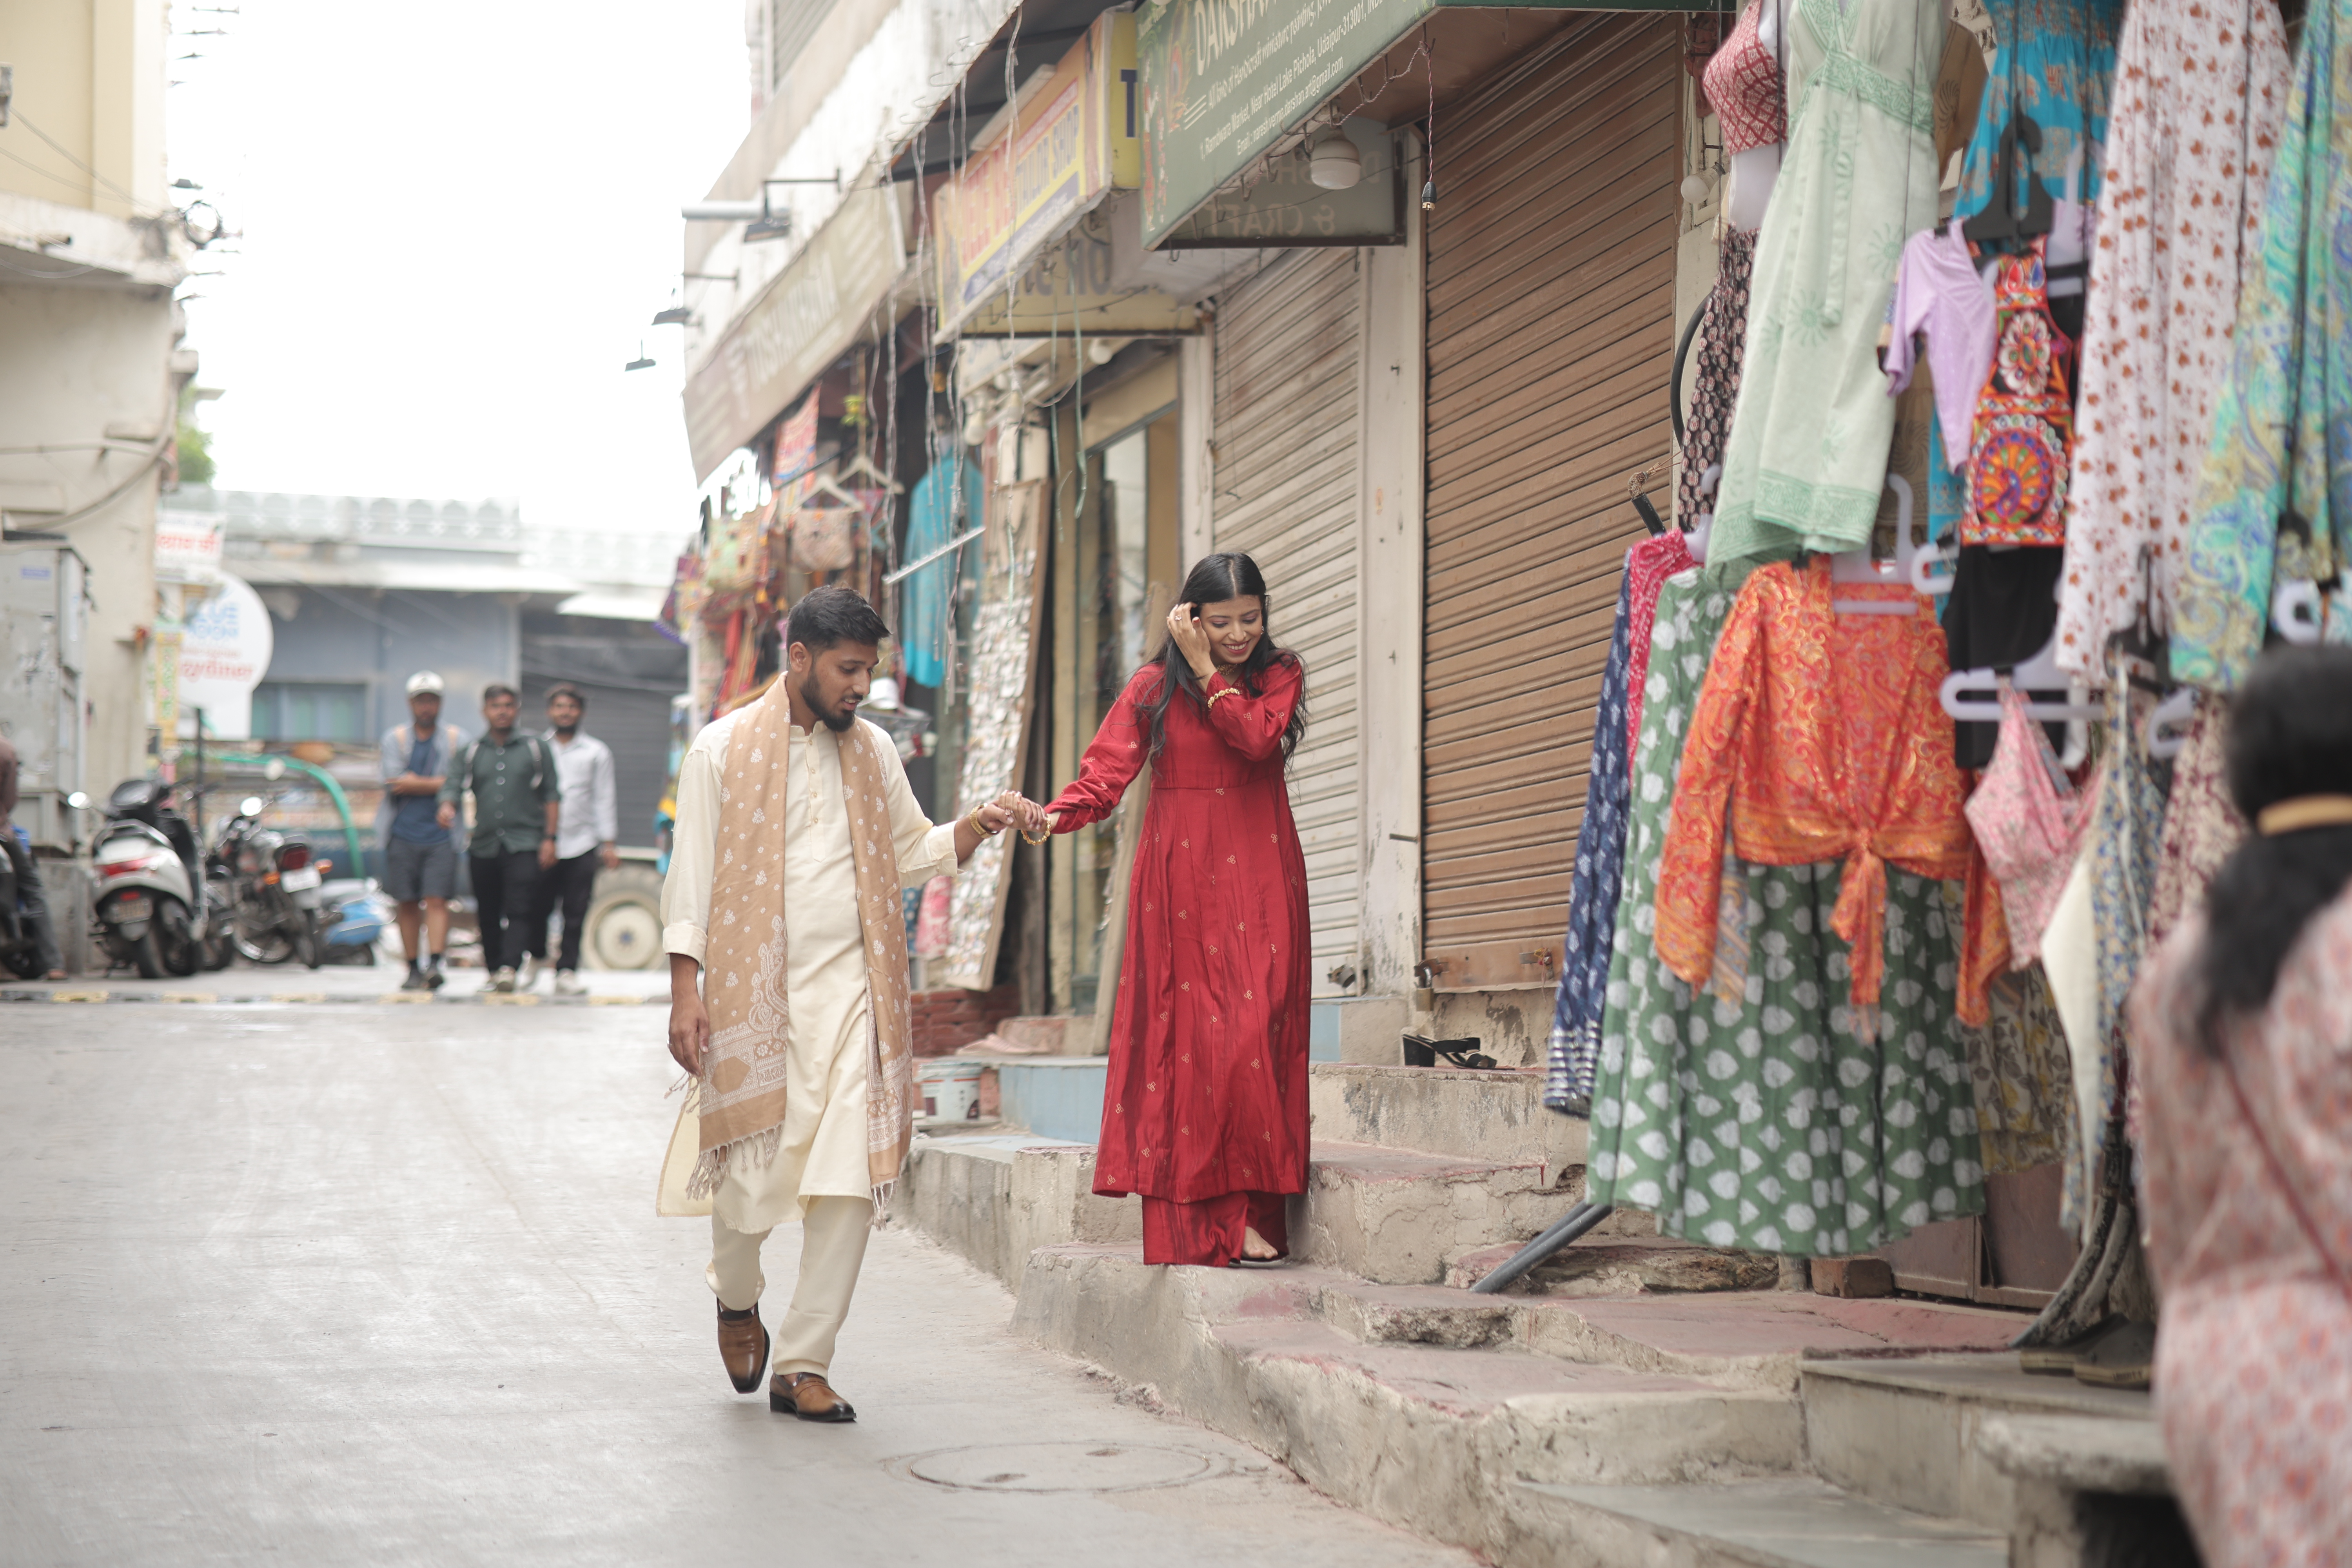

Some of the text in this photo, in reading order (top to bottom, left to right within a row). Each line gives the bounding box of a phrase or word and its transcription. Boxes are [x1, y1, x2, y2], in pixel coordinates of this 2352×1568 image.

[1250, 94, 1263, 116] Near
[1264, 76, 1278, 105] Hotel
[1279, 67, 1293, 92] Lake
[1294, 46, 1317, 80] Pichola,
[1317, 0, 1367, 58] Udaipur-313001,
[1237, 131, 1250, 156] Email
